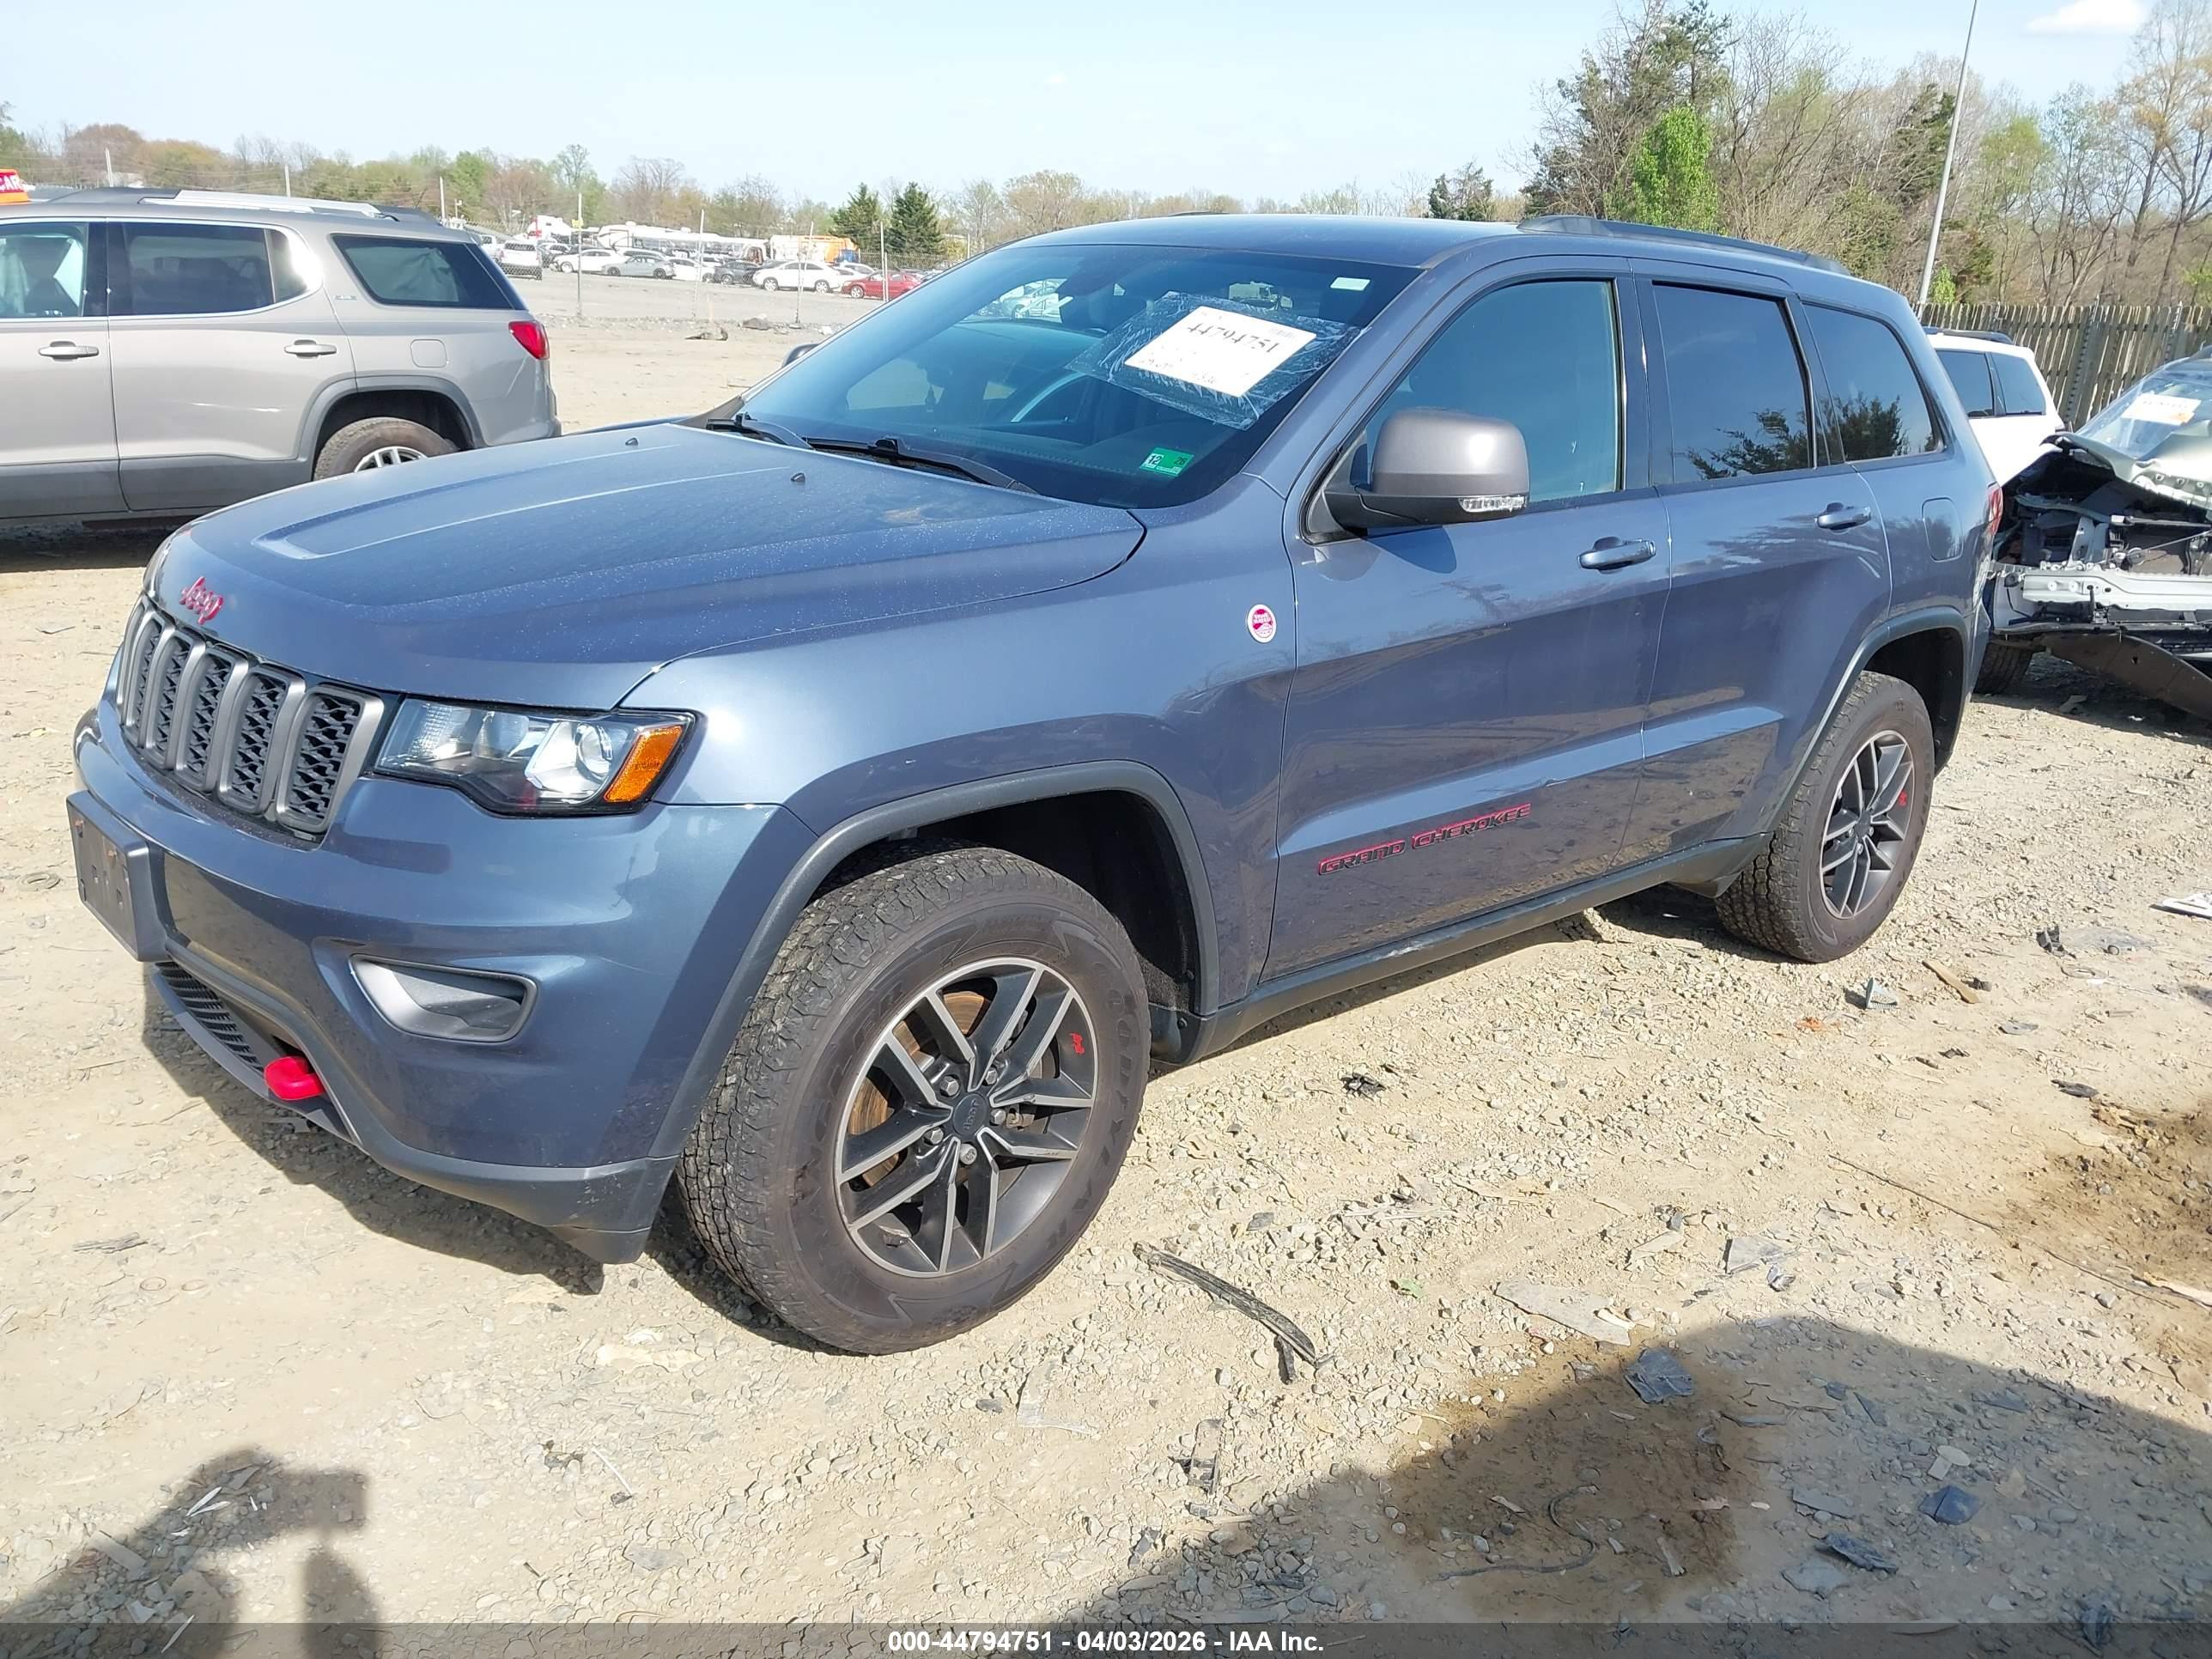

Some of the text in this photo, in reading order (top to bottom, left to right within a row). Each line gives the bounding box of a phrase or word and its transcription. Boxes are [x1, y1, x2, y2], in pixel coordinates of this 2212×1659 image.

[1187, 321, 1280, 354] 44794751
[1148, 454, 1188, 466] 12 26
[179, 576, 224, 625] Jeep
[1318, 802, 1532, 875] GRAND CHEROKEE
[963, 1097, 981, 1130] Jeep
